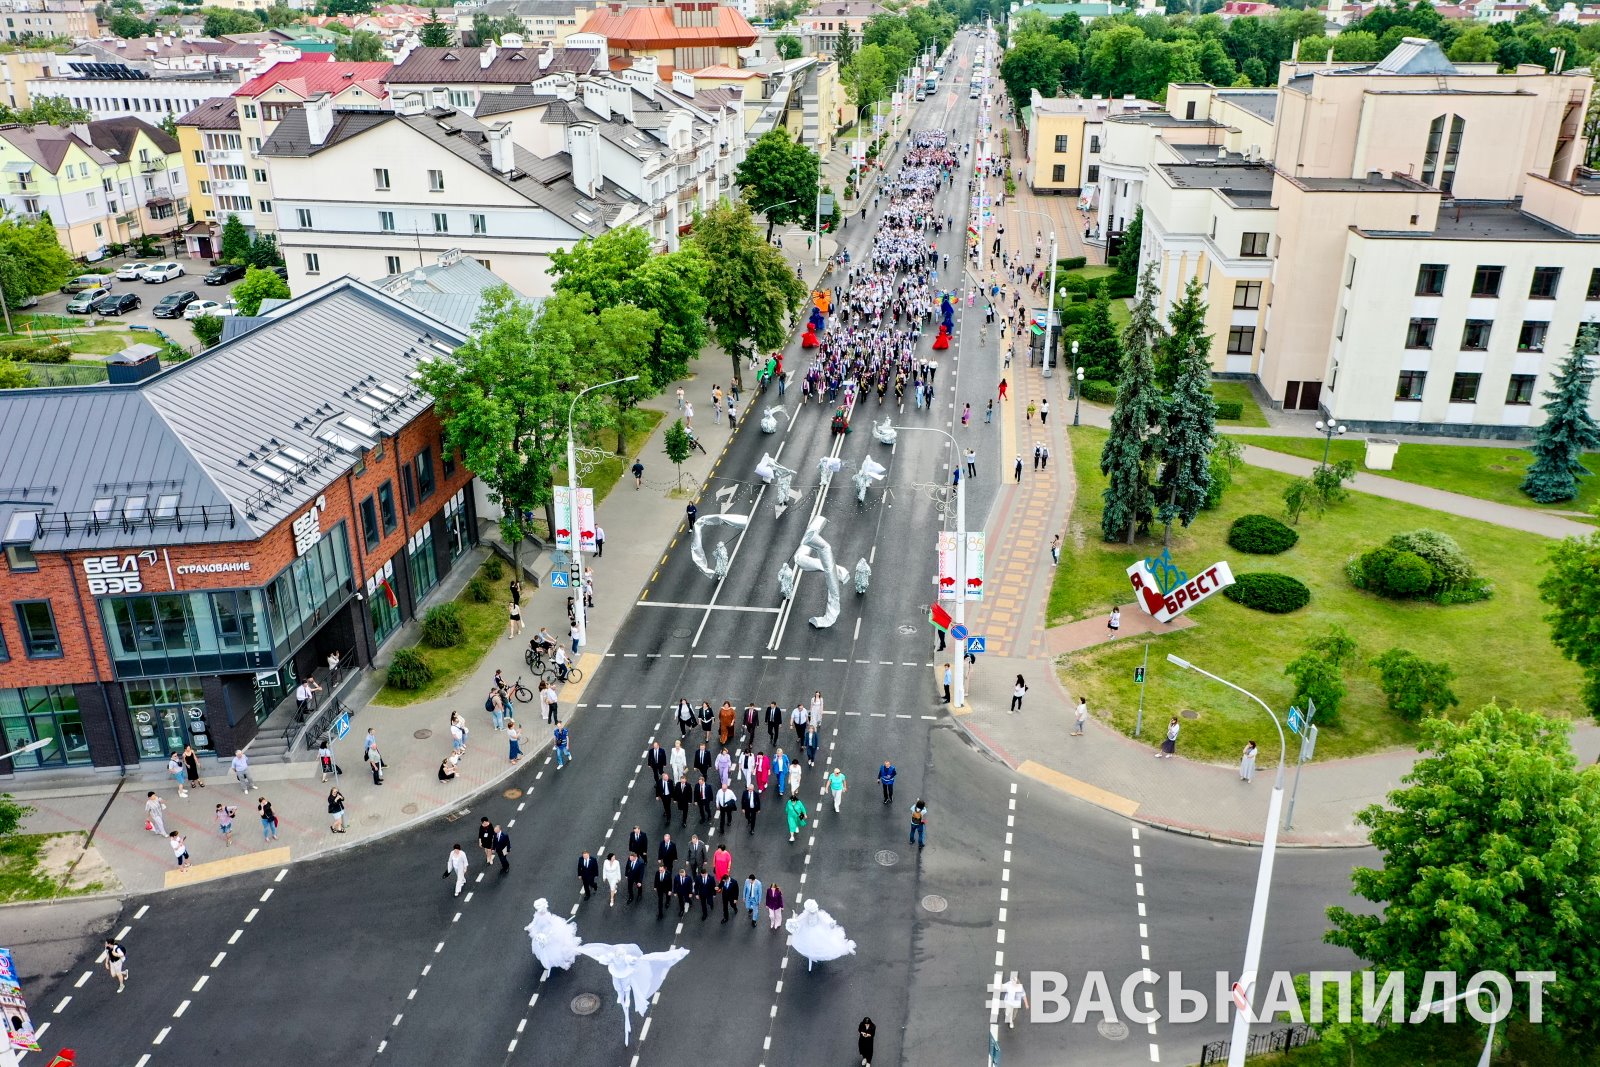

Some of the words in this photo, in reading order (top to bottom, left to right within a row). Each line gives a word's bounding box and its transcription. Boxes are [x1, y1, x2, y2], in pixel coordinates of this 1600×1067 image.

[293, 506, 319, 536] БЕЛ
[296, 526, 321, 557] ВЭБ
[83, 555, 139, 574] БЕЛ
[176, 561, 251, 575] СТРАХОВАНИЕ
[88, 576, 143, 595] ВЭБ
[1130, 572, 1144, 591] Я
[1163, 567, 1219, 614] БРЕСТ
